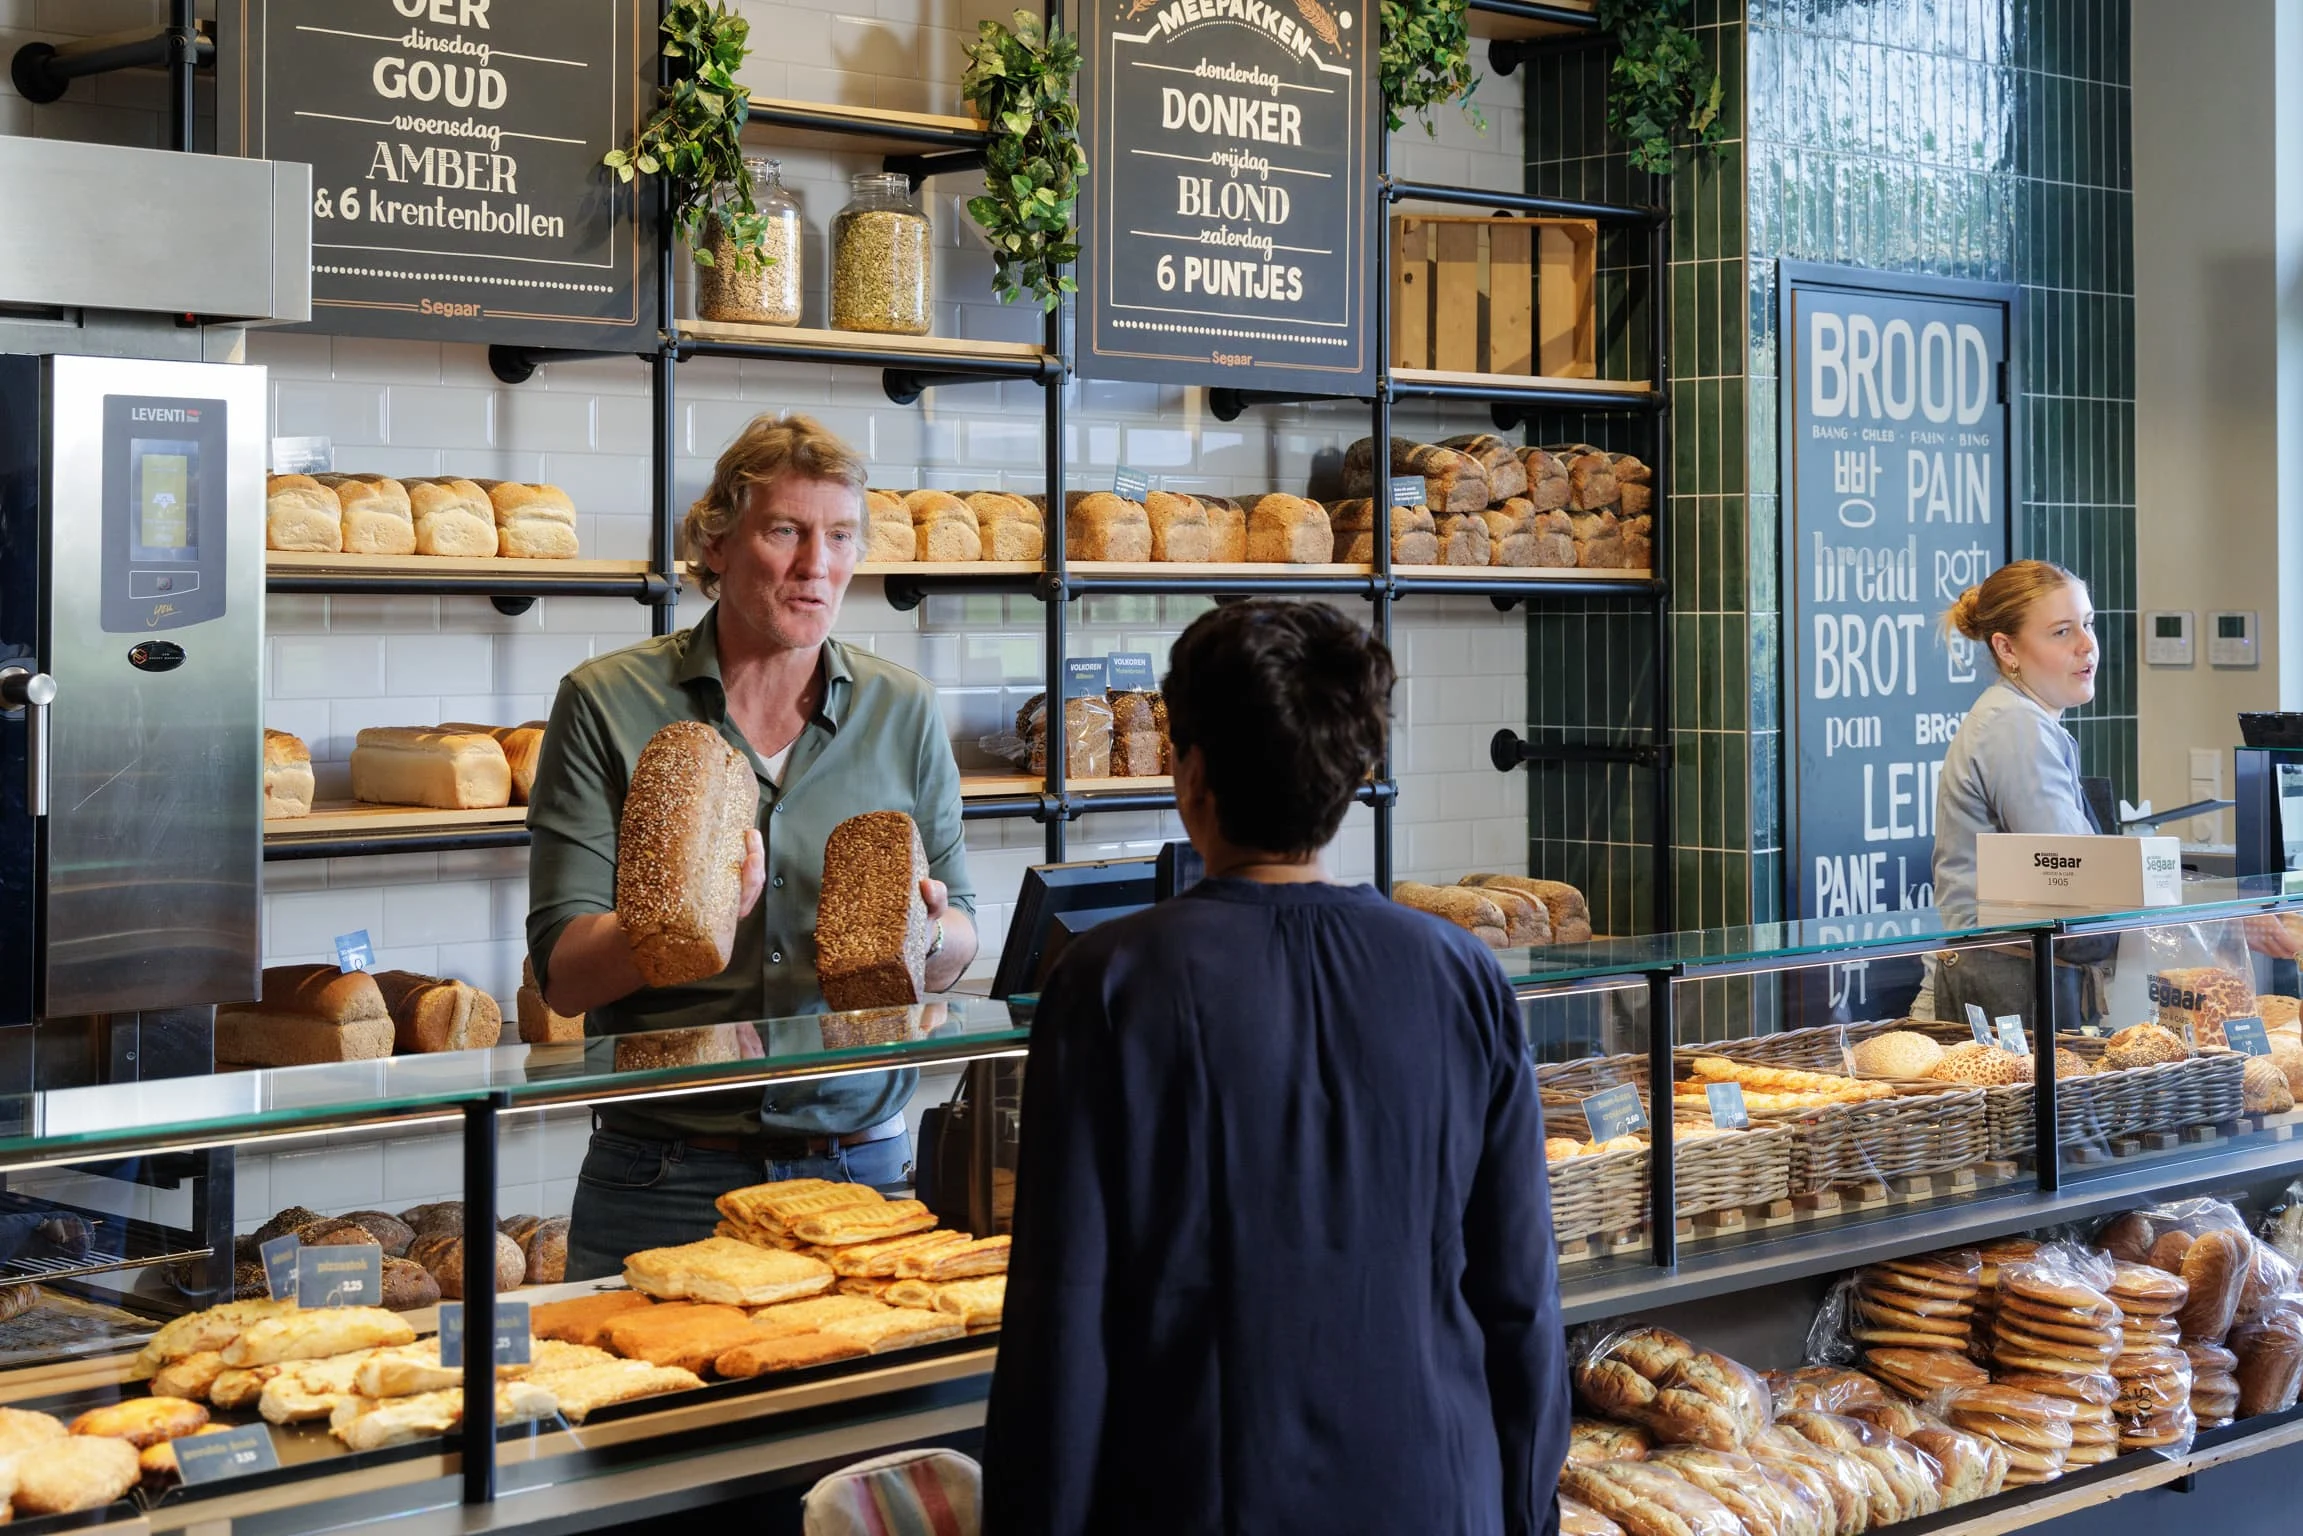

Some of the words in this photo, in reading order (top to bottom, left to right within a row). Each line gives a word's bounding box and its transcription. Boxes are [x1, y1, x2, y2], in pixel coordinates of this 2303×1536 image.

[401, 30, 491, 66] dinsdag
[1157, 0, 1311, 57] MEEPAKKEN
[373, 57, 507, 109] GOUD
[1195, 57, 1279, 96] donderdag
[392, 115, 501, 152] woensdag
[1162, 87, 1302, 146] DONKER
[365, 142, 517, 194] AMBER
[1209, 149, 1269, 181] vrijdag
[314, 189, 334, 219] &
[340, 187, 361, 220] 6
[370, 189, 564, 238] krentenbollen
[1176, 175, 1290, 225] BLOND
[1199, 224, 1273, 261] zaterdag
[1157, 254, 1176, 291] 6
[1184, 256, 1303, 302] PUNTJES
[420, 298, 481, 318] Segaar
[1211, 350, 1253, 367] Segaar
[1810, 312, 1989, 425] BROOD
[131, 407, 186, 422] LEVENTI
[1812, 425, 1849, 440] BAANG
[1959, 433, 1990, 447] BING
[1907, 449, 1991, 525] PAIN
[1813, 531, 1919, 603] bread
[1814, 614, 1924, 699] BROT
[1826, 715, 1881, 757] pan
[2034, 853, 2082, 869] Segaar
[2146, 856, 2176, 872] Segaar
[1816, 852, 1888, 919] PANE
